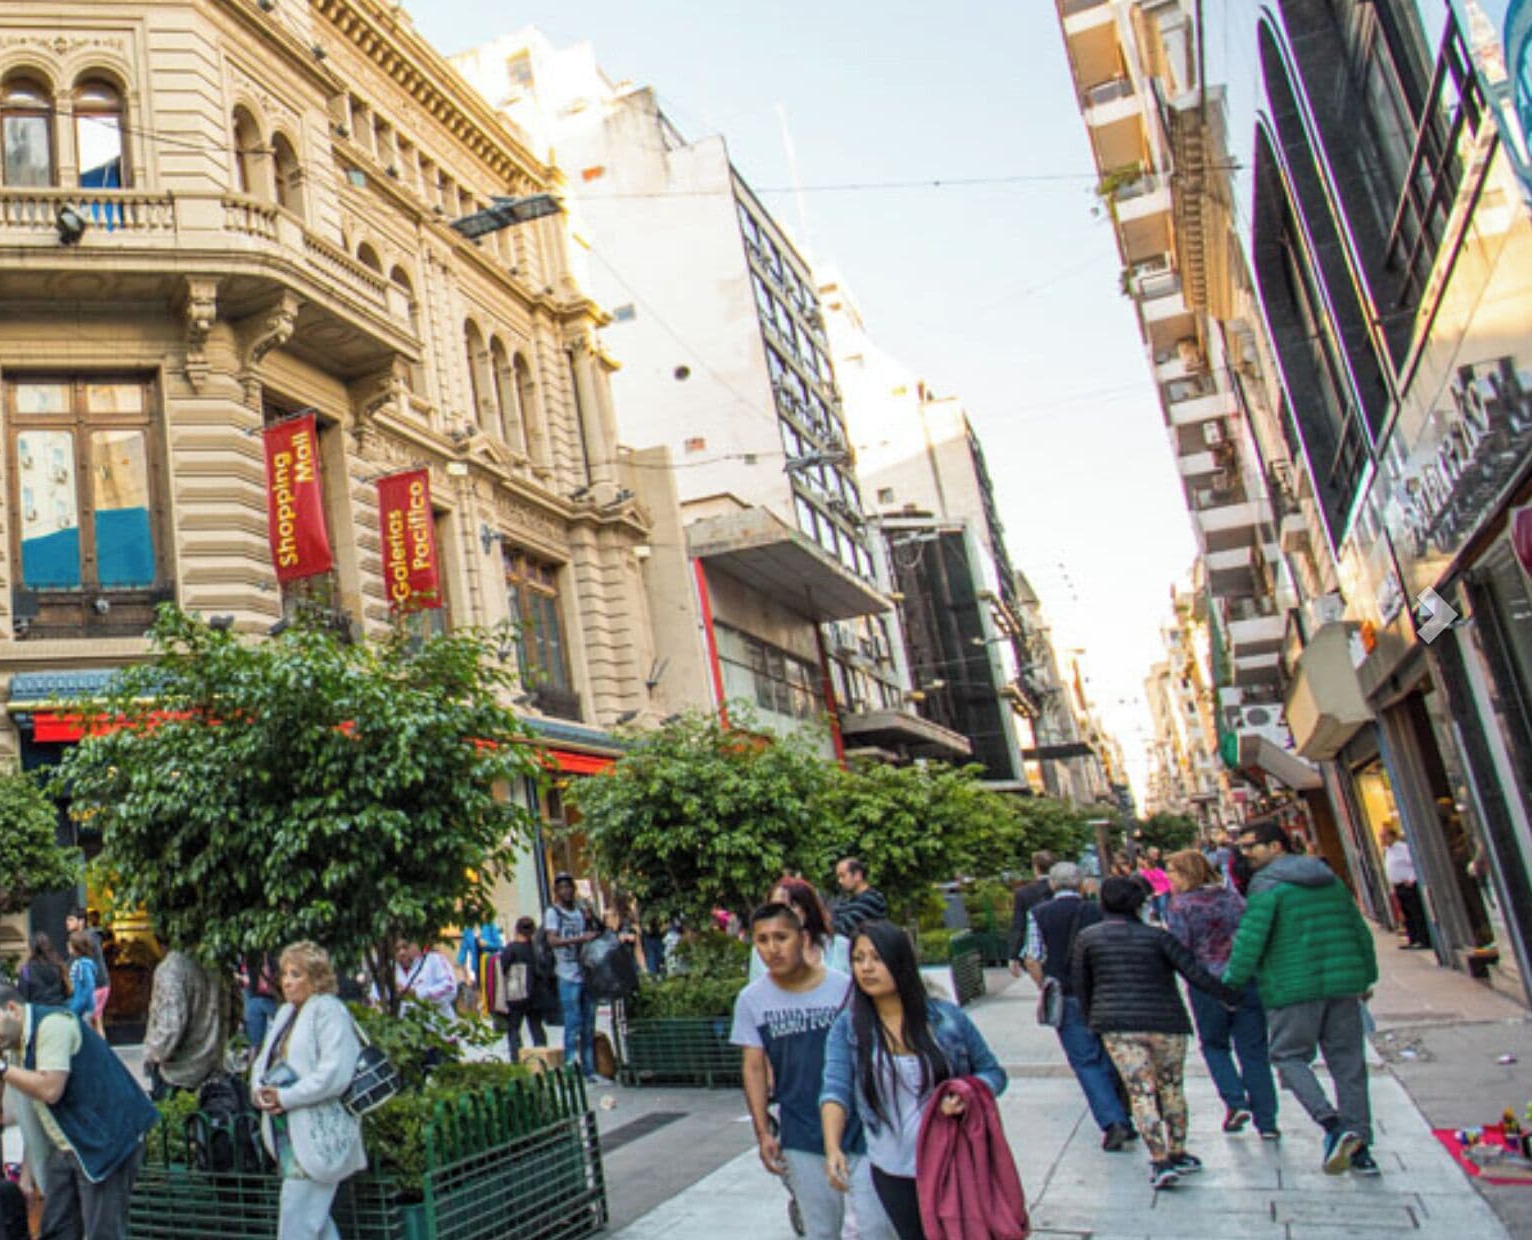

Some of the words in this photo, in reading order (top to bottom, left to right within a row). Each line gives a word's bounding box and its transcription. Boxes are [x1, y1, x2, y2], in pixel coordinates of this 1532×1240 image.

[292, 430, 314, 483] Mall
[272, 451, 299, 568] Shopping
[407, 481, 431, 570] Pacifico
[387, 509, 411, 602] Galerias
